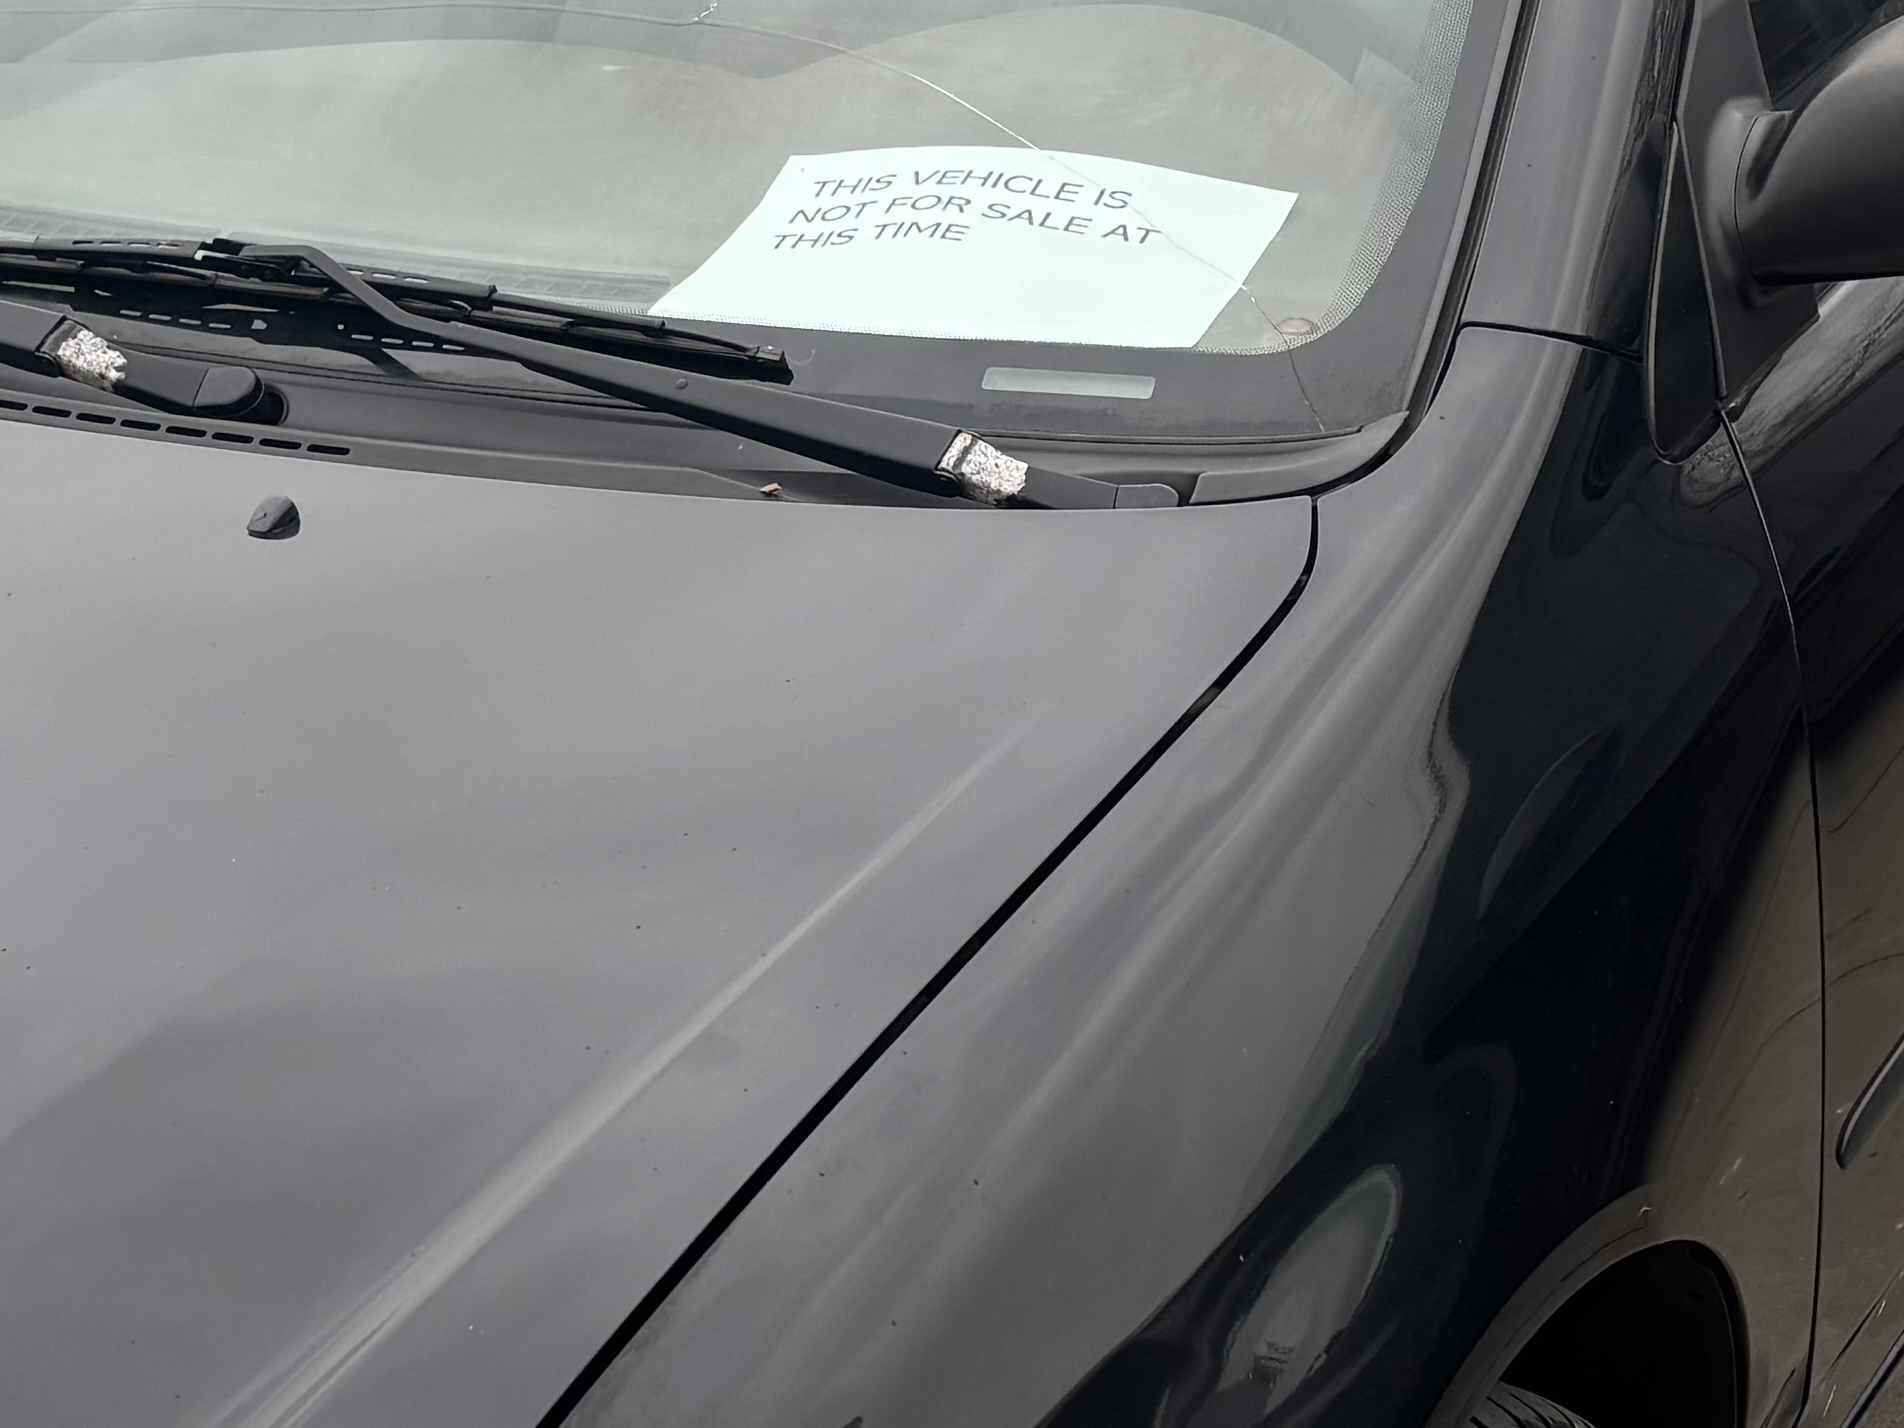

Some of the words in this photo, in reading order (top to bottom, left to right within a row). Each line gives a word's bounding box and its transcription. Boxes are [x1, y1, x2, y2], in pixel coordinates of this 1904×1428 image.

[812, 174, 897, 199] THIS
[912, 169, 1085, 203] VEHICLE
[1093, 188, 1133, 210] IS
[773, 228, 860, 250] THIS
[873, 221, 972, 242] TIME
[788, 200, 879, 225] NOT
[884, 194, 972, 215] FOR
[980, 203, 1094, 235] SALE
[1100, 224, 1163, 246] AT
